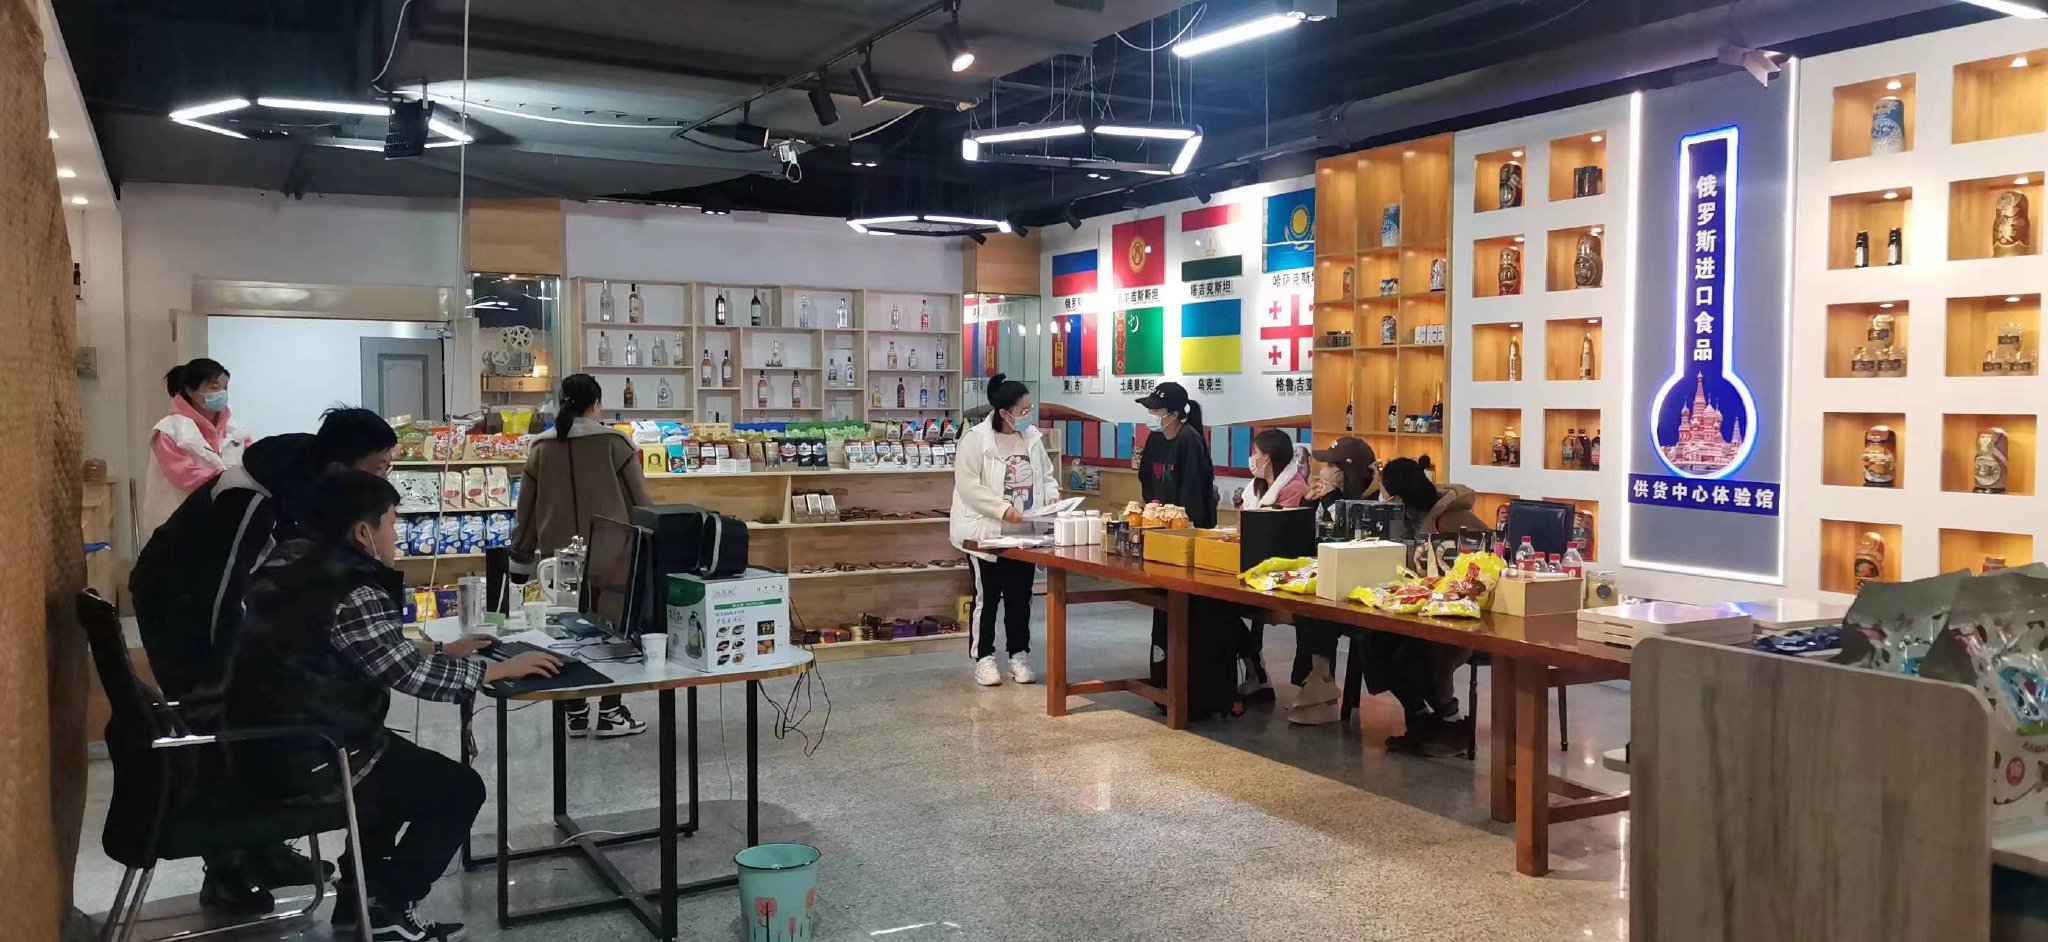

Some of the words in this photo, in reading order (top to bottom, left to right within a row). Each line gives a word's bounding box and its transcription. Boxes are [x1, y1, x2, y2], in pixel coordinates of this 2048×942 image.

[1693, 174, 1718, 361] 俄罗斯进口食品
[1118, 288, 1159, 303] 吉斯斯坦
[1190, 280, 1231, 296] 塔吉克斯坦
[1120, 378, 1155, 391] 土库曼斯坦
[1198, 378, 1222, 391] 乌克兰
[1276, 377, 1312, 392] 格鲁吉亚
[1633, 480, 1775, 510] 供货中心体验馆
